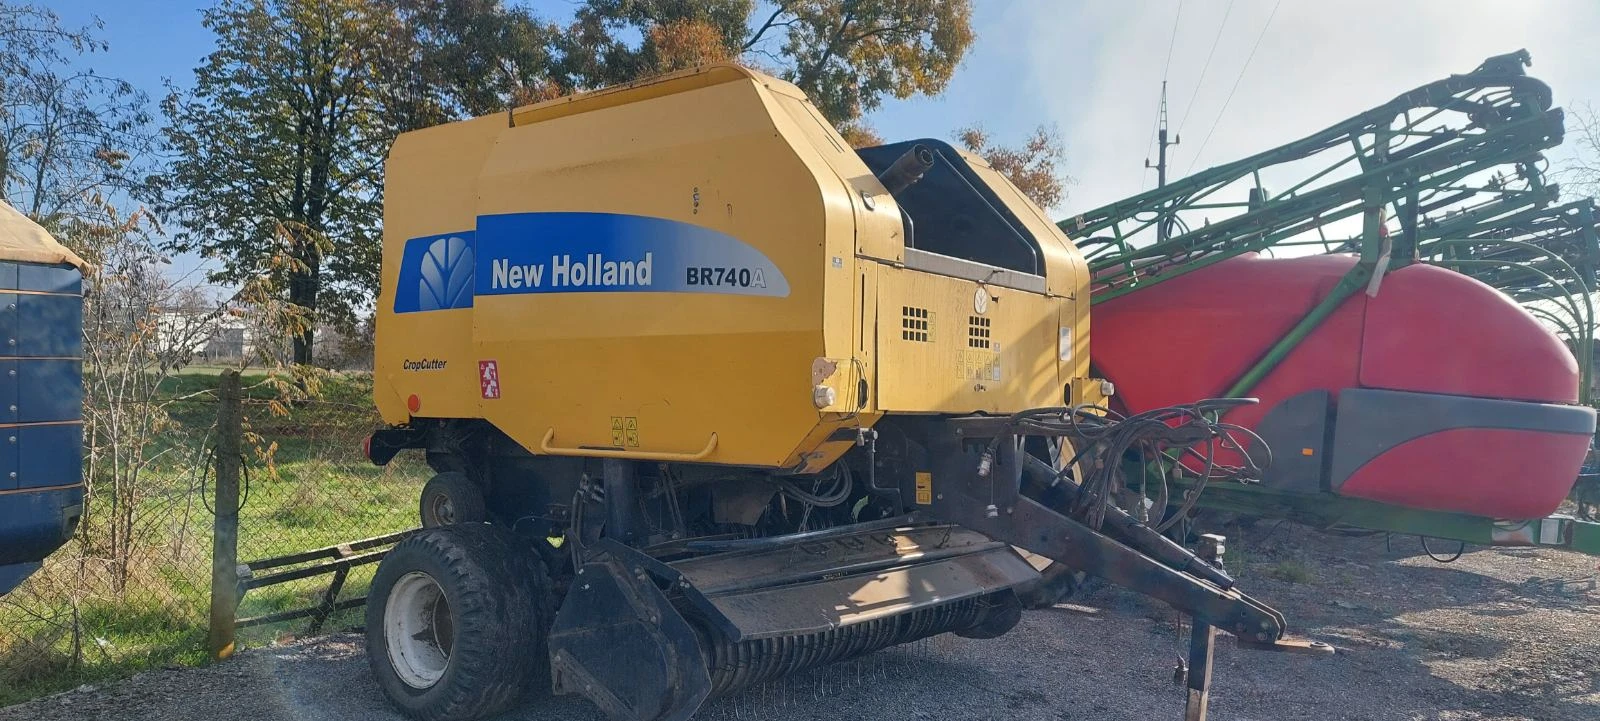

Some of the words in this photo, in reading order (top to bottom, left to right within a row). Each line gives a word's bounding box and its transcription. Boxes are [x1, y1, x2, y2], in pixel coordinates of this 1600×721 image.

[491, 258, 545, 289] New
[551, 252, 653, 287] Holland
[686, 267, 767, 289] BR740A
[403, 358, 447, 371] CropCutter
